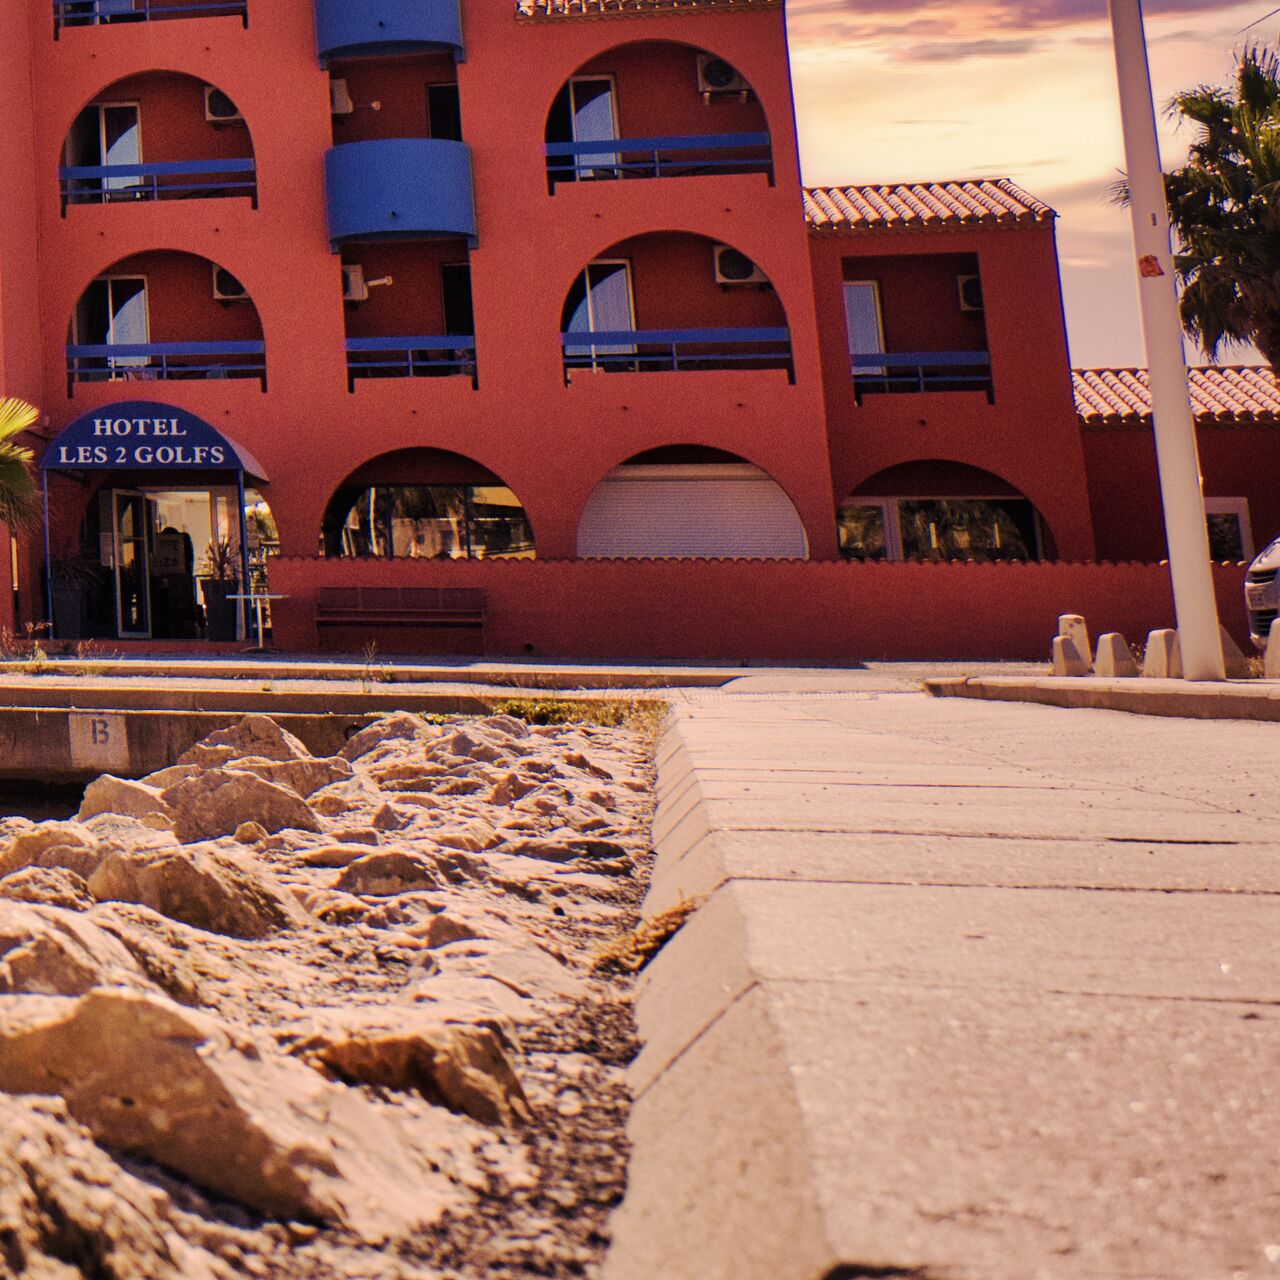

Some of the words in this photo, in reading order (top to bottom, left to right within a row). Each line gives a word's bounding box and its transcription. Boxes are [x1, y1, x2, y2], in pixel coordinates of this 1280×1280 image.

[93, 418, 187, 436] HOTEL
[59, 446, 108, 464] LES
[115, 446, 127, 463] 2
[134, 446, 225, 464] GOLFS
[91, 718, 110, 745] B
